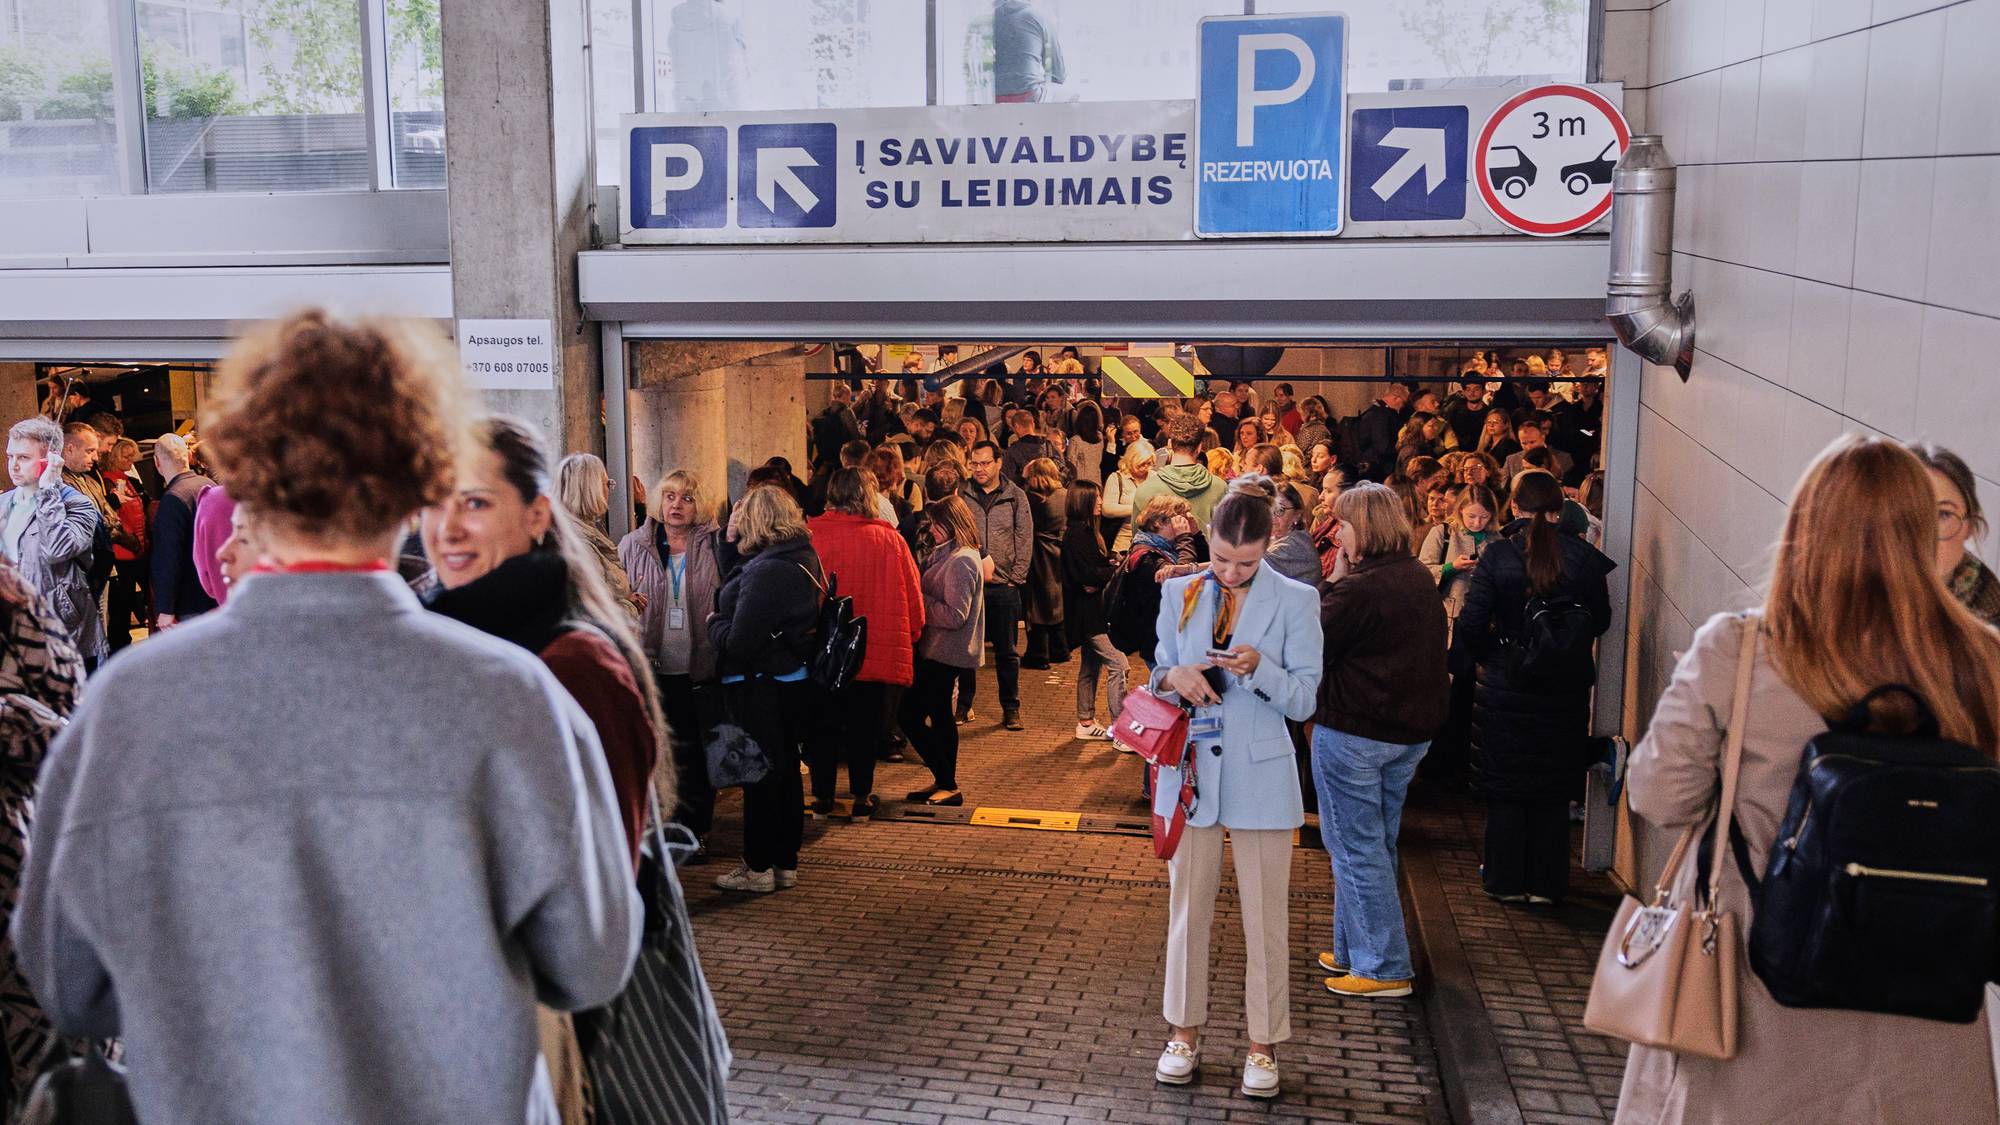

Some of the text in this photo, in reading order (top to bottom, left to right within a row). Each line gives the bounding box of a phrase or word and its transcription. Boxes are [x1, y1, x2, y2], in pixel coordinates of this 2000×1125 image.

[1236, 33, 1316, 147] P
[1532, 112, 1586, 139] 3 m
[855, 133, 1187, 174] Į SAVIVALDYBĘ
[650, 143, 703, 216] P
[1203, 159, 1332, 182] REZERVUOTA
[866, 175, 1173, 209] SU LEIDIMAIS
[468, 335, 544, 347] Apsaugos tel.
[494, 362, 513, 373] 608
[516, 363, 549, 373] 07005
